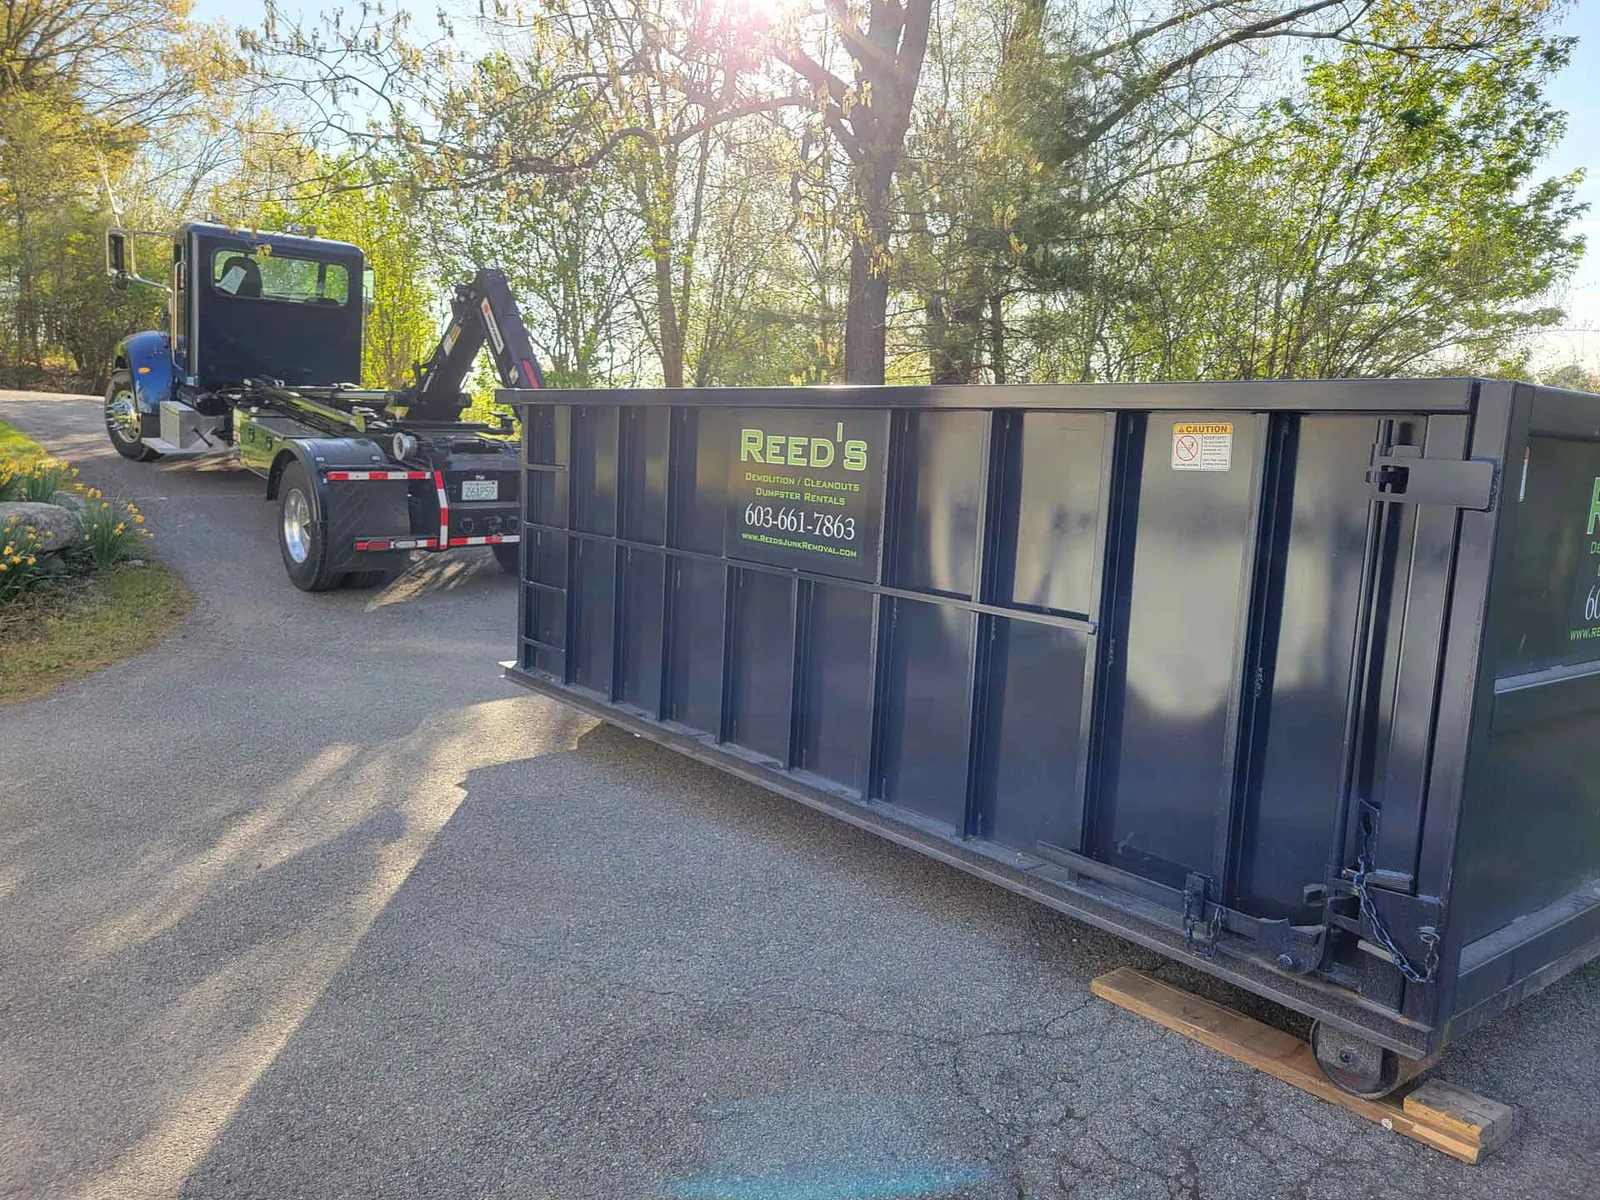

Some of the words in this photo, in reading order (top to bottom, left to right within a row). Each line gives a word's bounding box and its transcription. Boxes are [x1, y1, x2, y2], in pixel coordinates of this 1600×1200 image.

[740, 422, 868, 471] REED'S
[745, 472, 795, 486] DEMOLITION
[804, 478, 860, 492] CLEANOUTS
[755, 487, 801, 500] DUMPSTER
[804, 493, 846, 506] RENTALS
[745, 501, 855, 541] 603-661-7863
[741, 532, 857, 557] WWW.REEDSJUNKREMOVAL.COM
